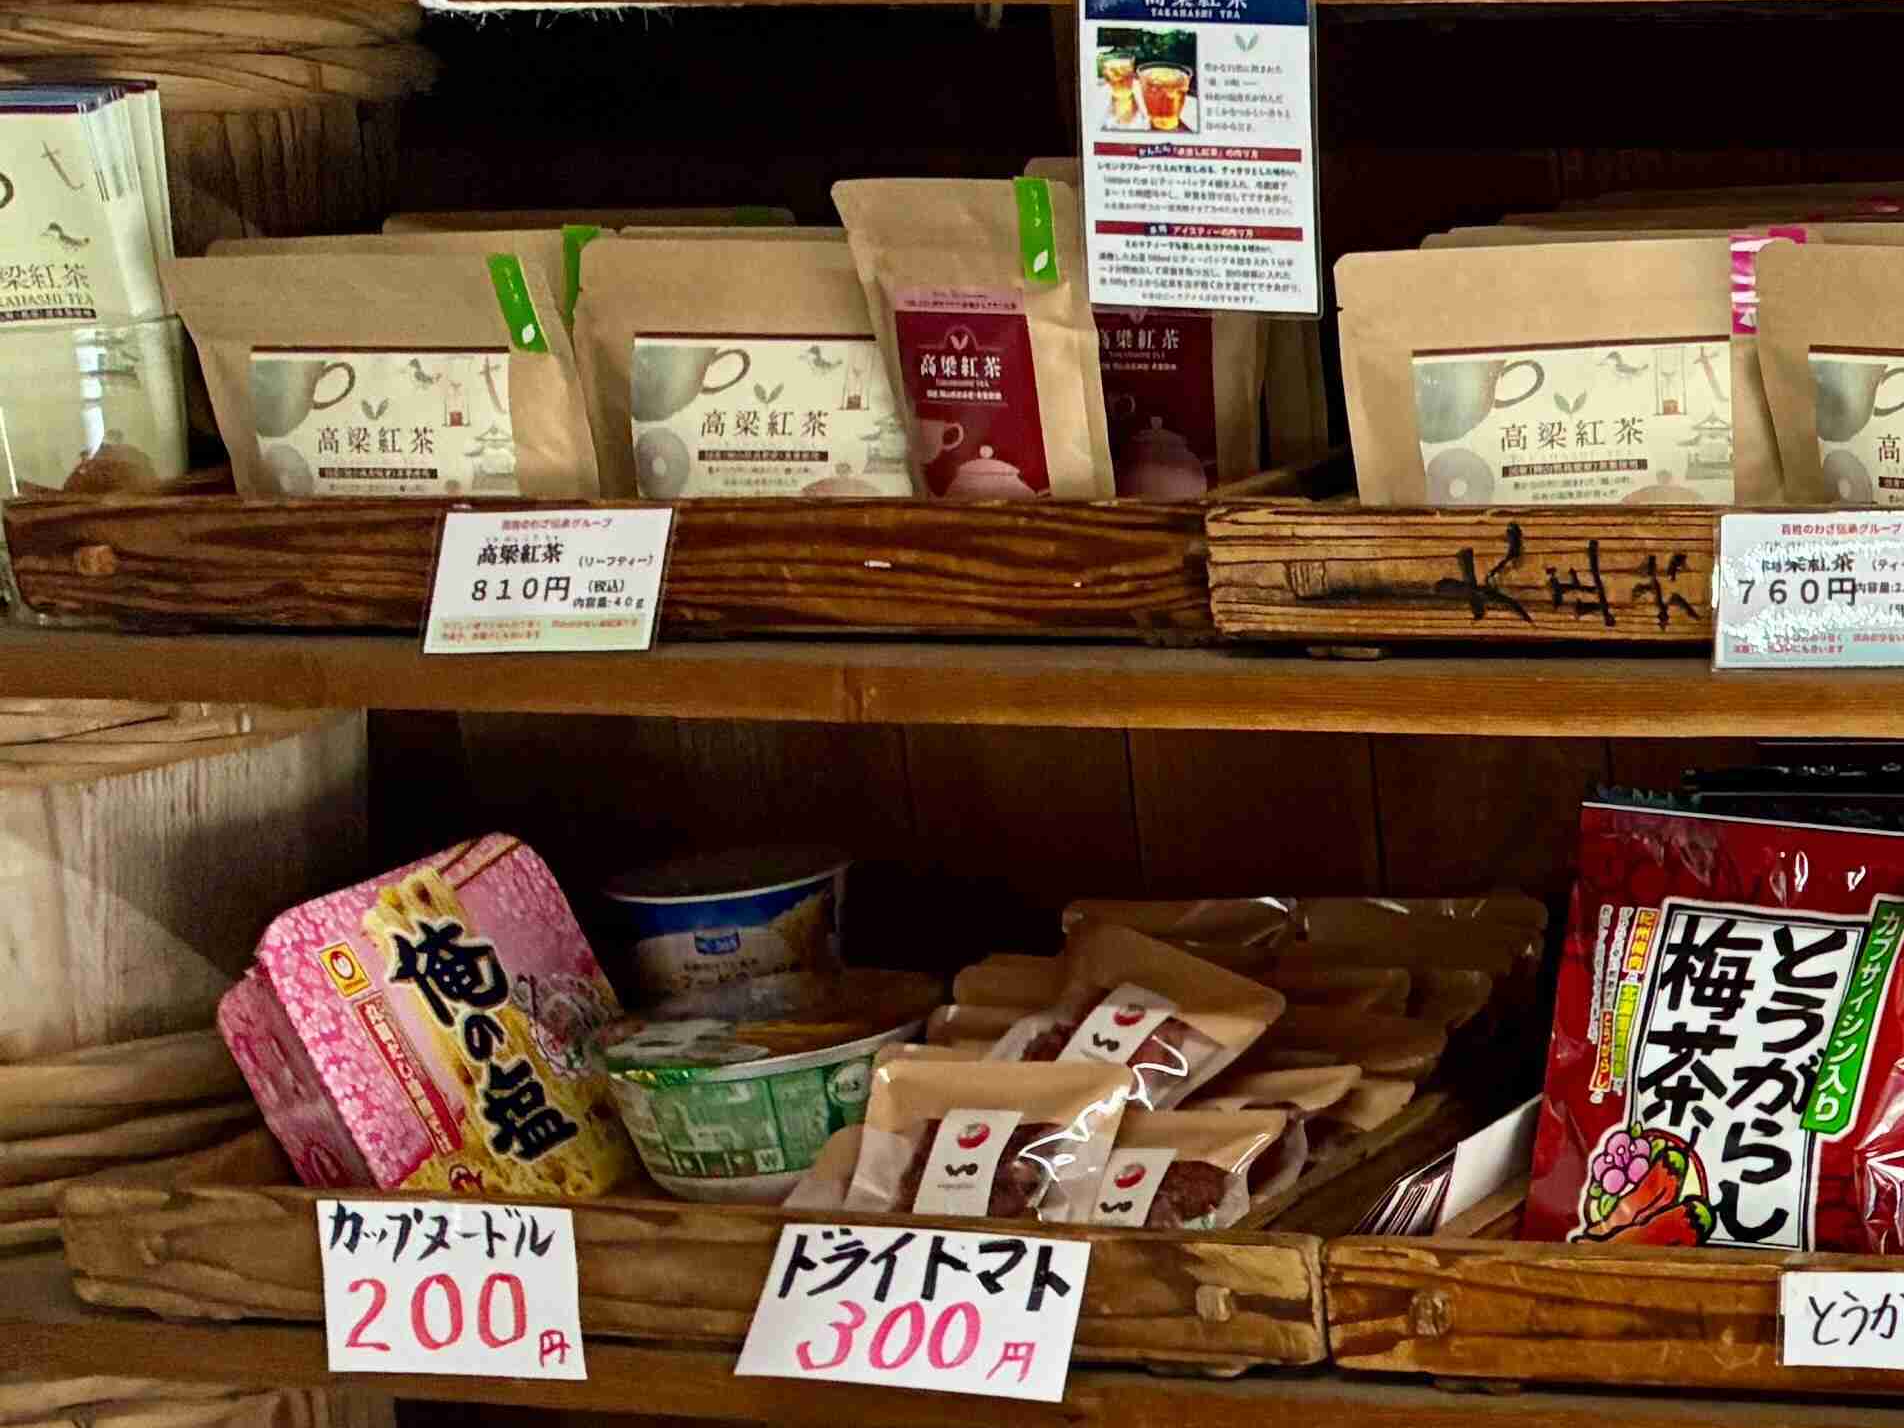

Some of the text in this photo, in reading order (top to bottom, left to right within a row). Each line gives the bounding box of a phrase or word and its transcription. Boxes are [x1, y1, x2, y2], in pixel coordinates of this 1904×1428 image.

[919, 353, 1002, 379] 高梁紅茶
[318, 425, 435, 455] 高梁紅茶
[700, 407, 830, 438] 高梁紅茶
[1499, 416, 1645, 453] 高梁紅茶
[477, 543, 564, 567] 高梁紅茶
[471, 576, 572, 602] 810円
[1737, 576, 1856, 607] 760円
[388, 920, 580, 1163] 俺の塩
[1636, 916, 1756, 1130] 梅茶
[1712, 923, 1849, 1243] とうがらし
[327, 1200, 556, 1262] カップヌードル
[776, 1225, 1072, 1313] ドライトマト
[344, 1271, 573, 1368] 200円
[795, 1299, 1037, 1384] 300円
